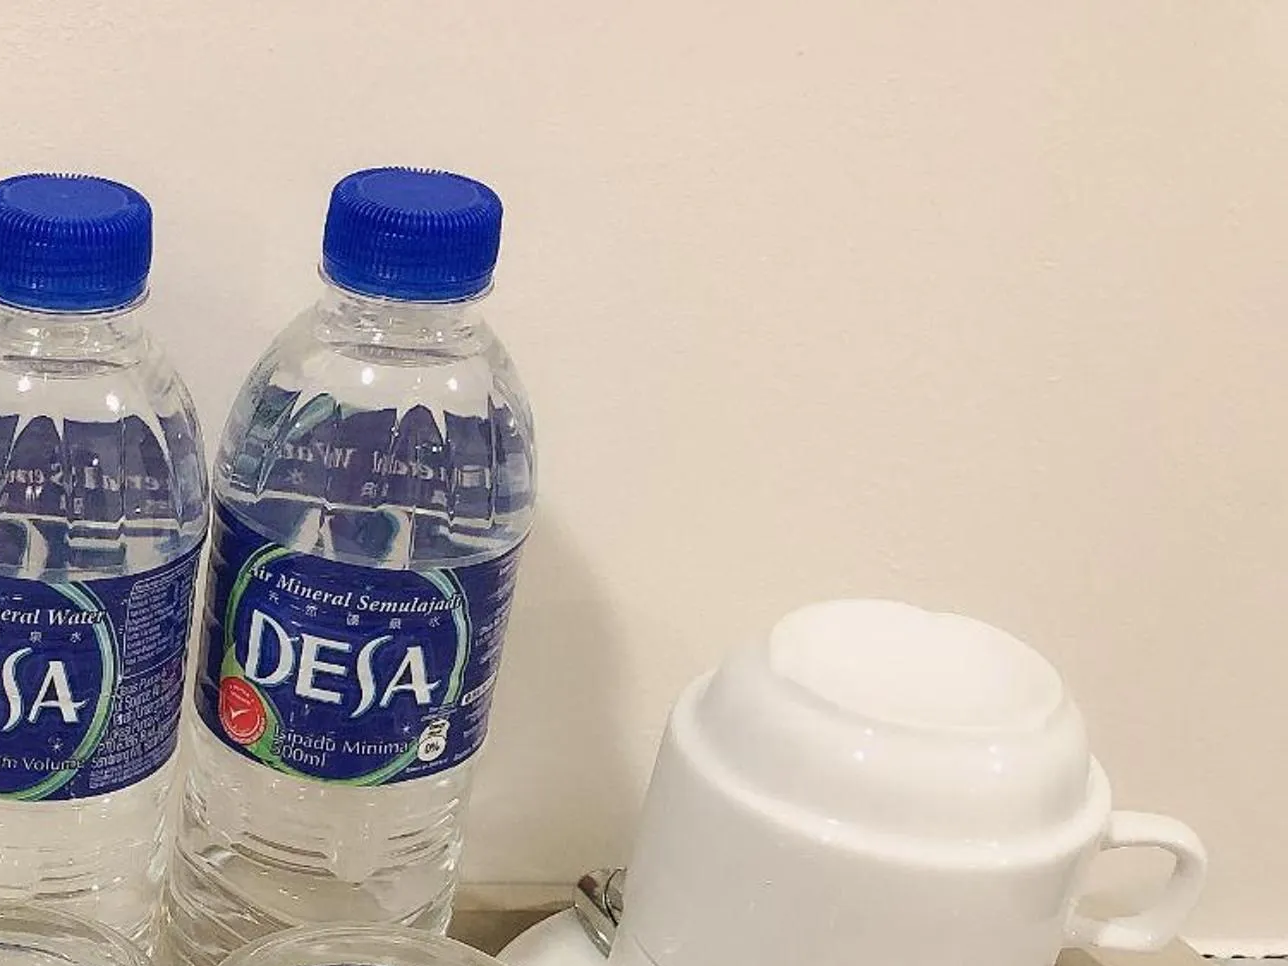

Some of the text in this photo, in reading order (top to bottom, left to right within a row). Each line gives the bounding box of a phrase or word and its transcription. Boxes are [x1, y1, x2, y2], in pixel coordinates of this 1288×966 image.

[249, 564, 462, 617] Air Mineral Semulajadi
[47, 608, 106, 626] Water
[244, 609, 442, 718] DESA
[23, 757, 84, 771] Volume
